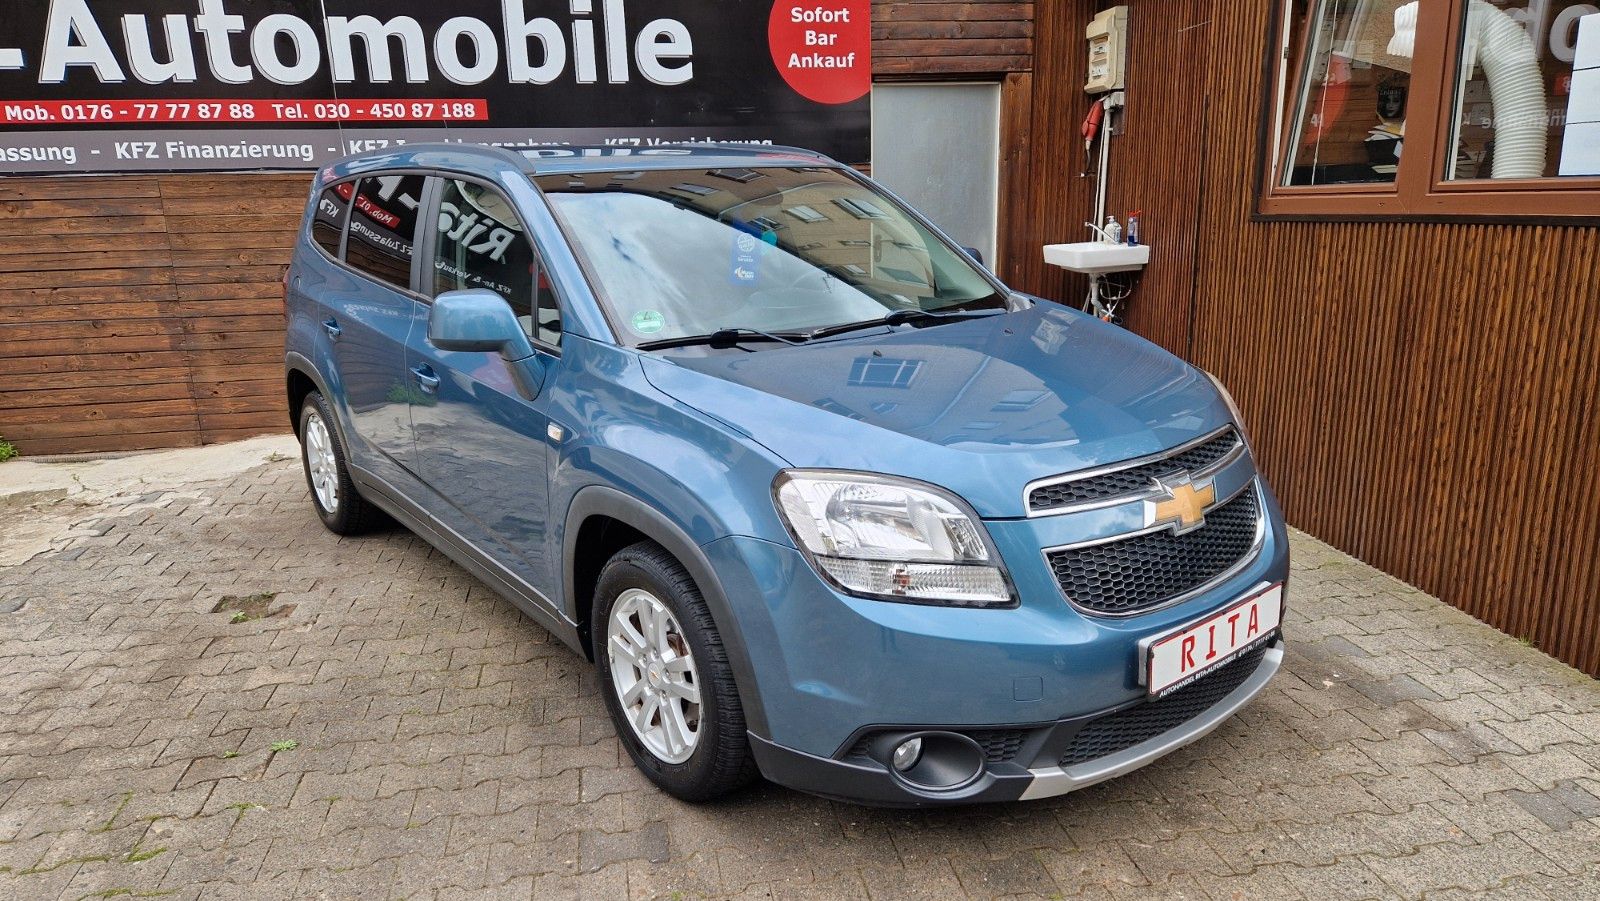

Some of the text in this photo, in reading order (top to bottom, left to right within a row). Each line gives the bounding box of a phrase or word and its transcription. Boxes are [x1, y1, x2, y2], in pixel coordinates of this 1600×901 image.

[792, 7, 850, 23] Sofort
[805, 30, 838, 46] Bar
[788, 52, 855, 68] Ankauf
[5, 105, 55, 121] Mob.
[61, 104, 114, 120] 0176
[133, 104, 159, 119] 77
[165, 104, 191, 119] 77
[197, 104, 222, 119] 87
[229, 104, 255, 119] 88
[272, 104, 308, 119] Tel.
[314, 104, 350, 119] 030
[370, 103, 406, 118] 450
[411, 103, 434, 118] 87
[441, 103, 476, 118] 188
[114, 142, 160, 160] KFZ
[165, 141, 313, 162] Finanzierung
[1159, 676, 1196, 698] AUTOHANDEL
